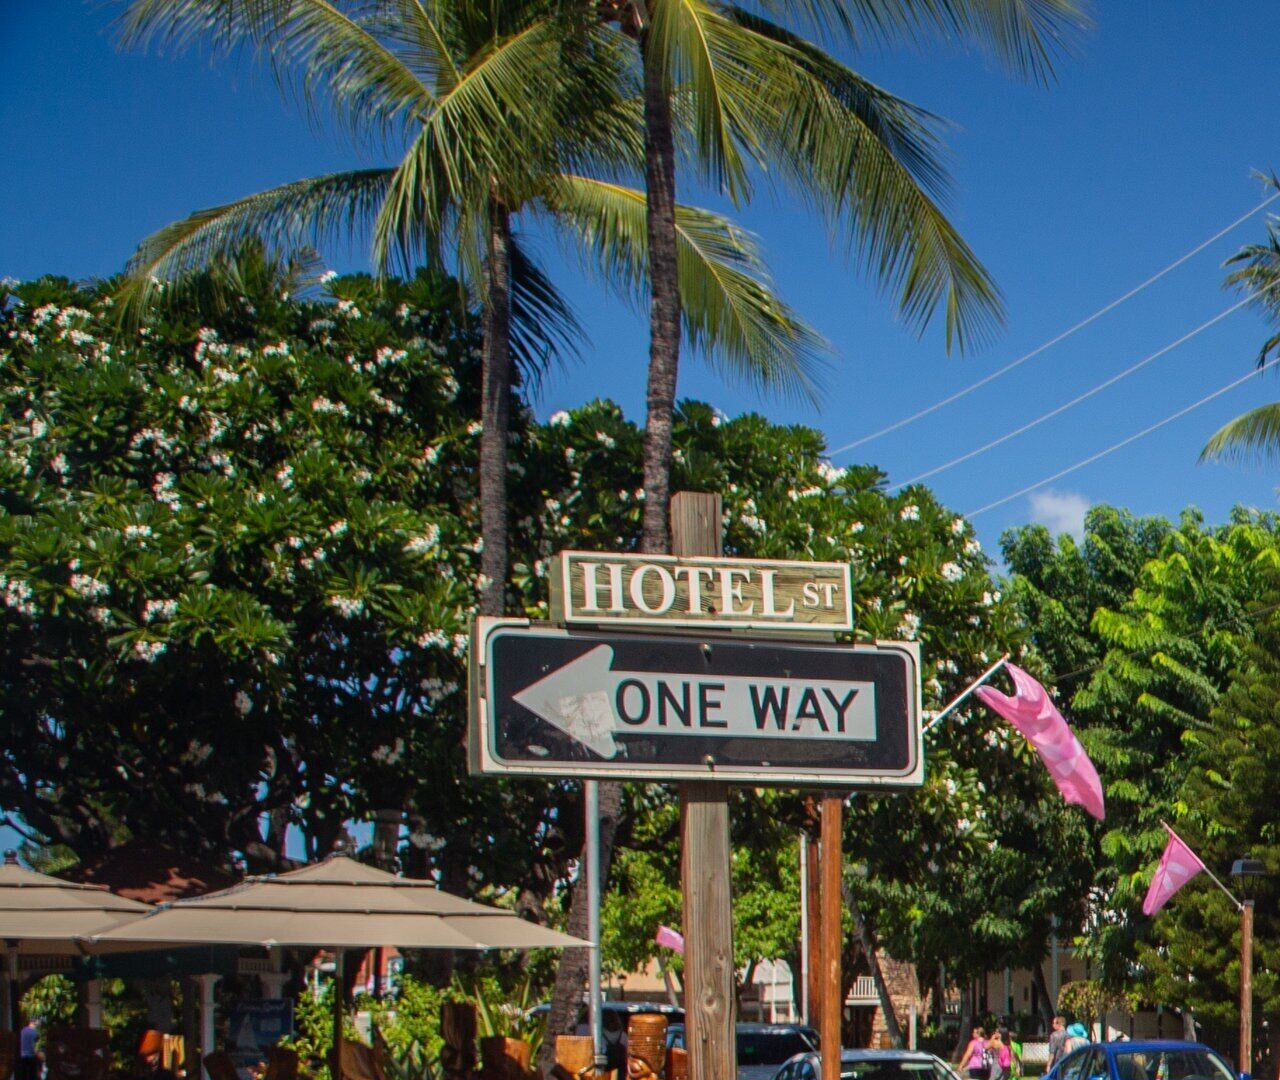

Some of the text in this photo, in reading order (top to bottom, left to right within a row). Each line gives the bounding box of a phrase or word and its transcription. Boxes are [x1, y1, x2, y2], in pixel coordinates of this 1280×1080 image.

[578, 561, 838, 618] HOTEL ST
[616, 677, 860, 733] ONE WAY
